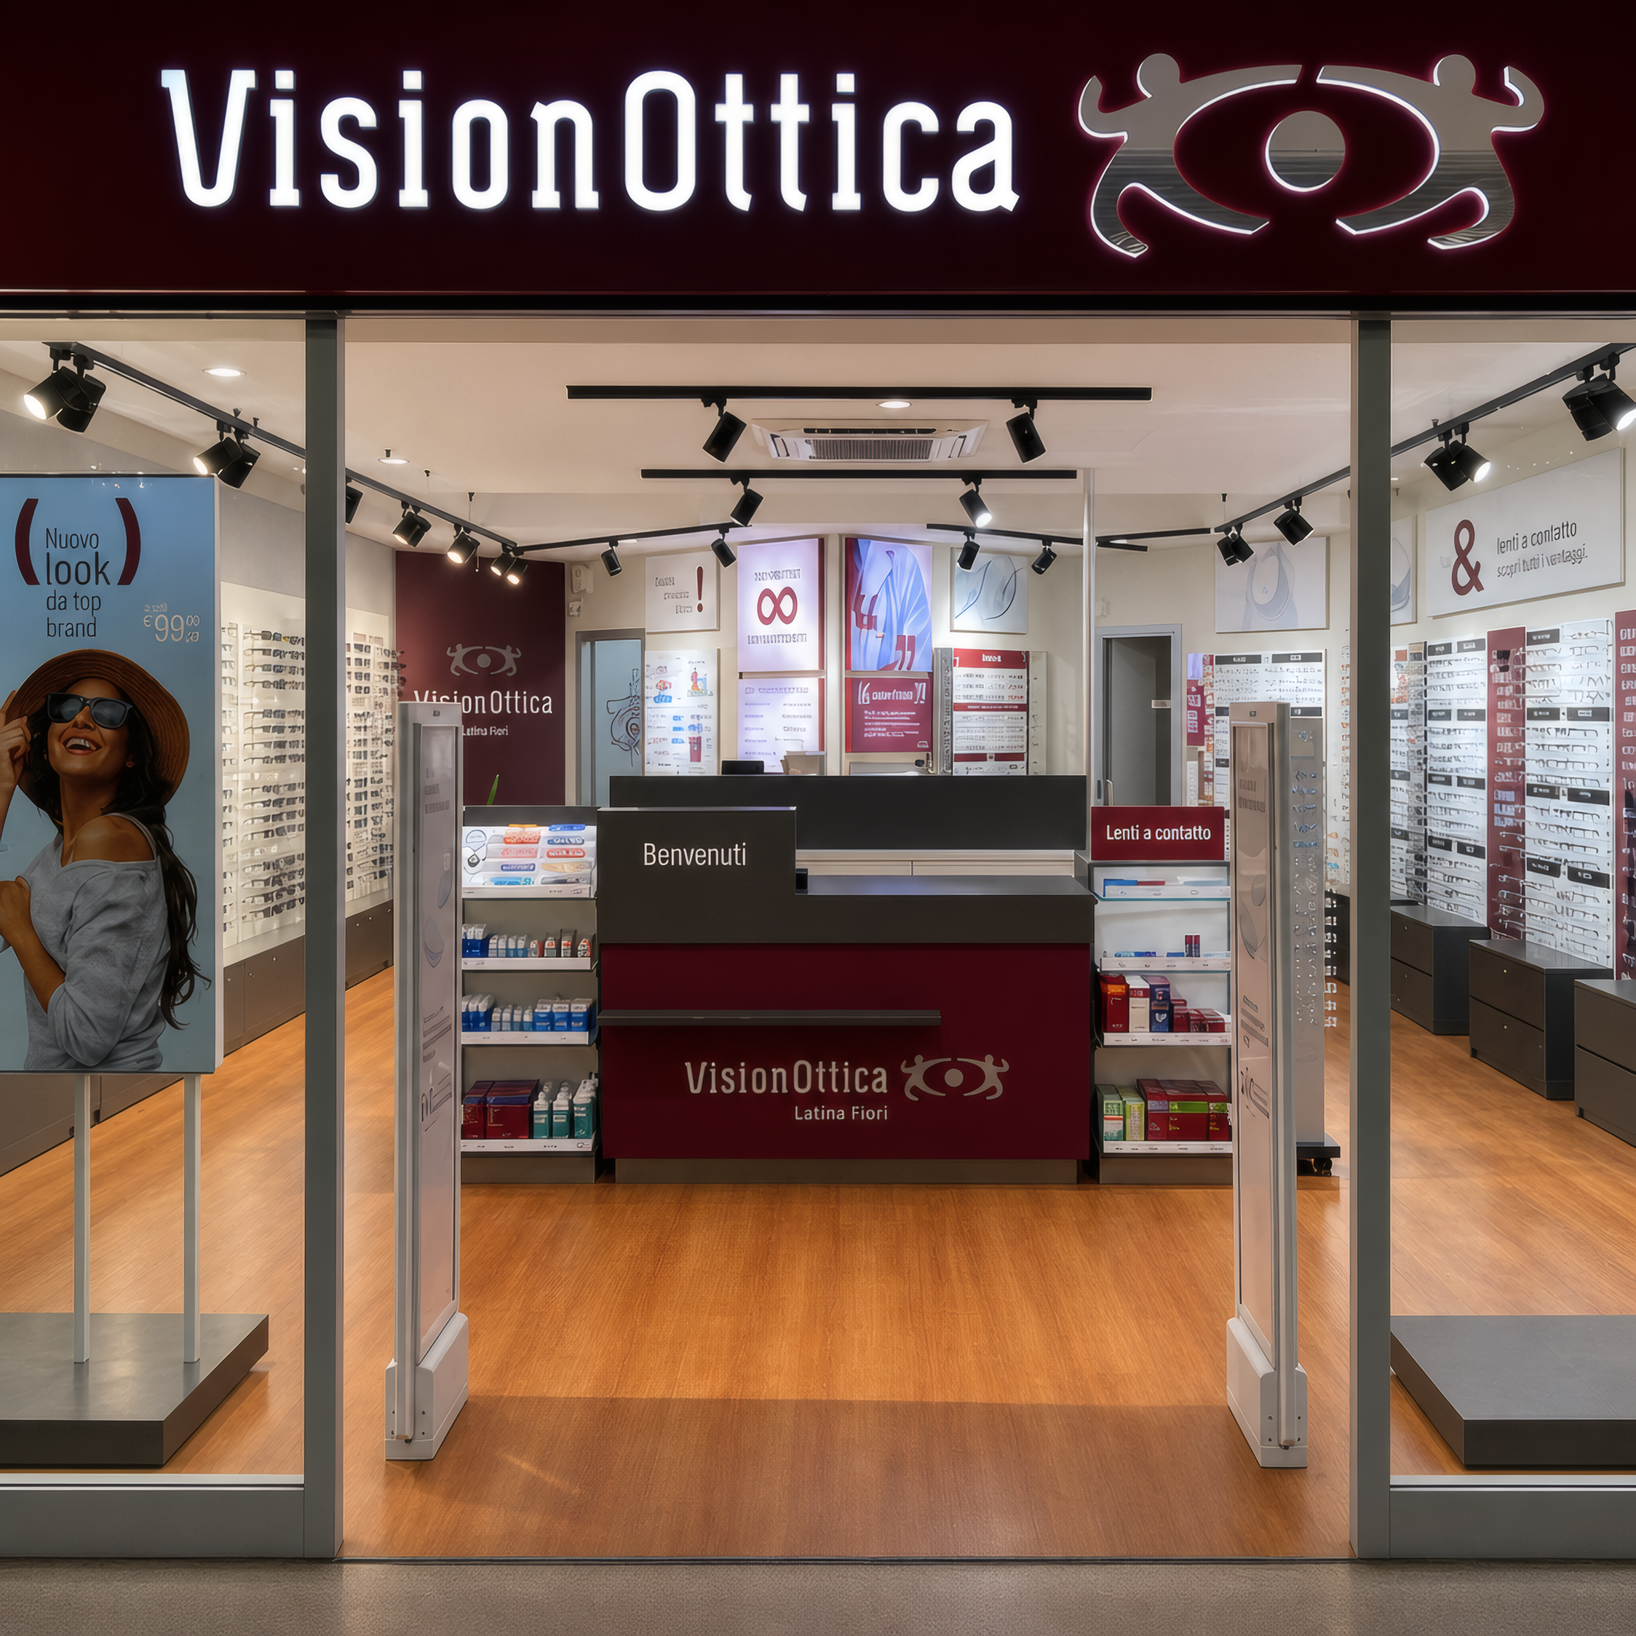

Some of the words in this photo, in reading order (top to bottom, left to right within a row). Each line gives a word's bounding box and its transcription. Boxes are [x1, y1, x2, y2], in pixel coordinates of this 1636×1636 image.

[161, 69, 1020, 213] VisionOttica
[46, 527, 99, 549] Nuovo
[1496, 532, 1519, 555] lenti
[1521, 535, 1528, 549] a
[46, 551, 111, 585] look
[46, 589, 67, 611] da
[73, 591, 102, 616] top
[46, 616, 97, 638] brand
[1106, 824, 1140, 841] Lenti
[1143, 828, 1152, 841] a
[1155, 824, 1212, 841] contatto
[643, 842, 746, 866] Benvenuti
[684, 1059, 888, 1094] VisionOttica
[794, 1105, 845, 1121] Latina
[851, 1105, 888, 1121] Fiori
